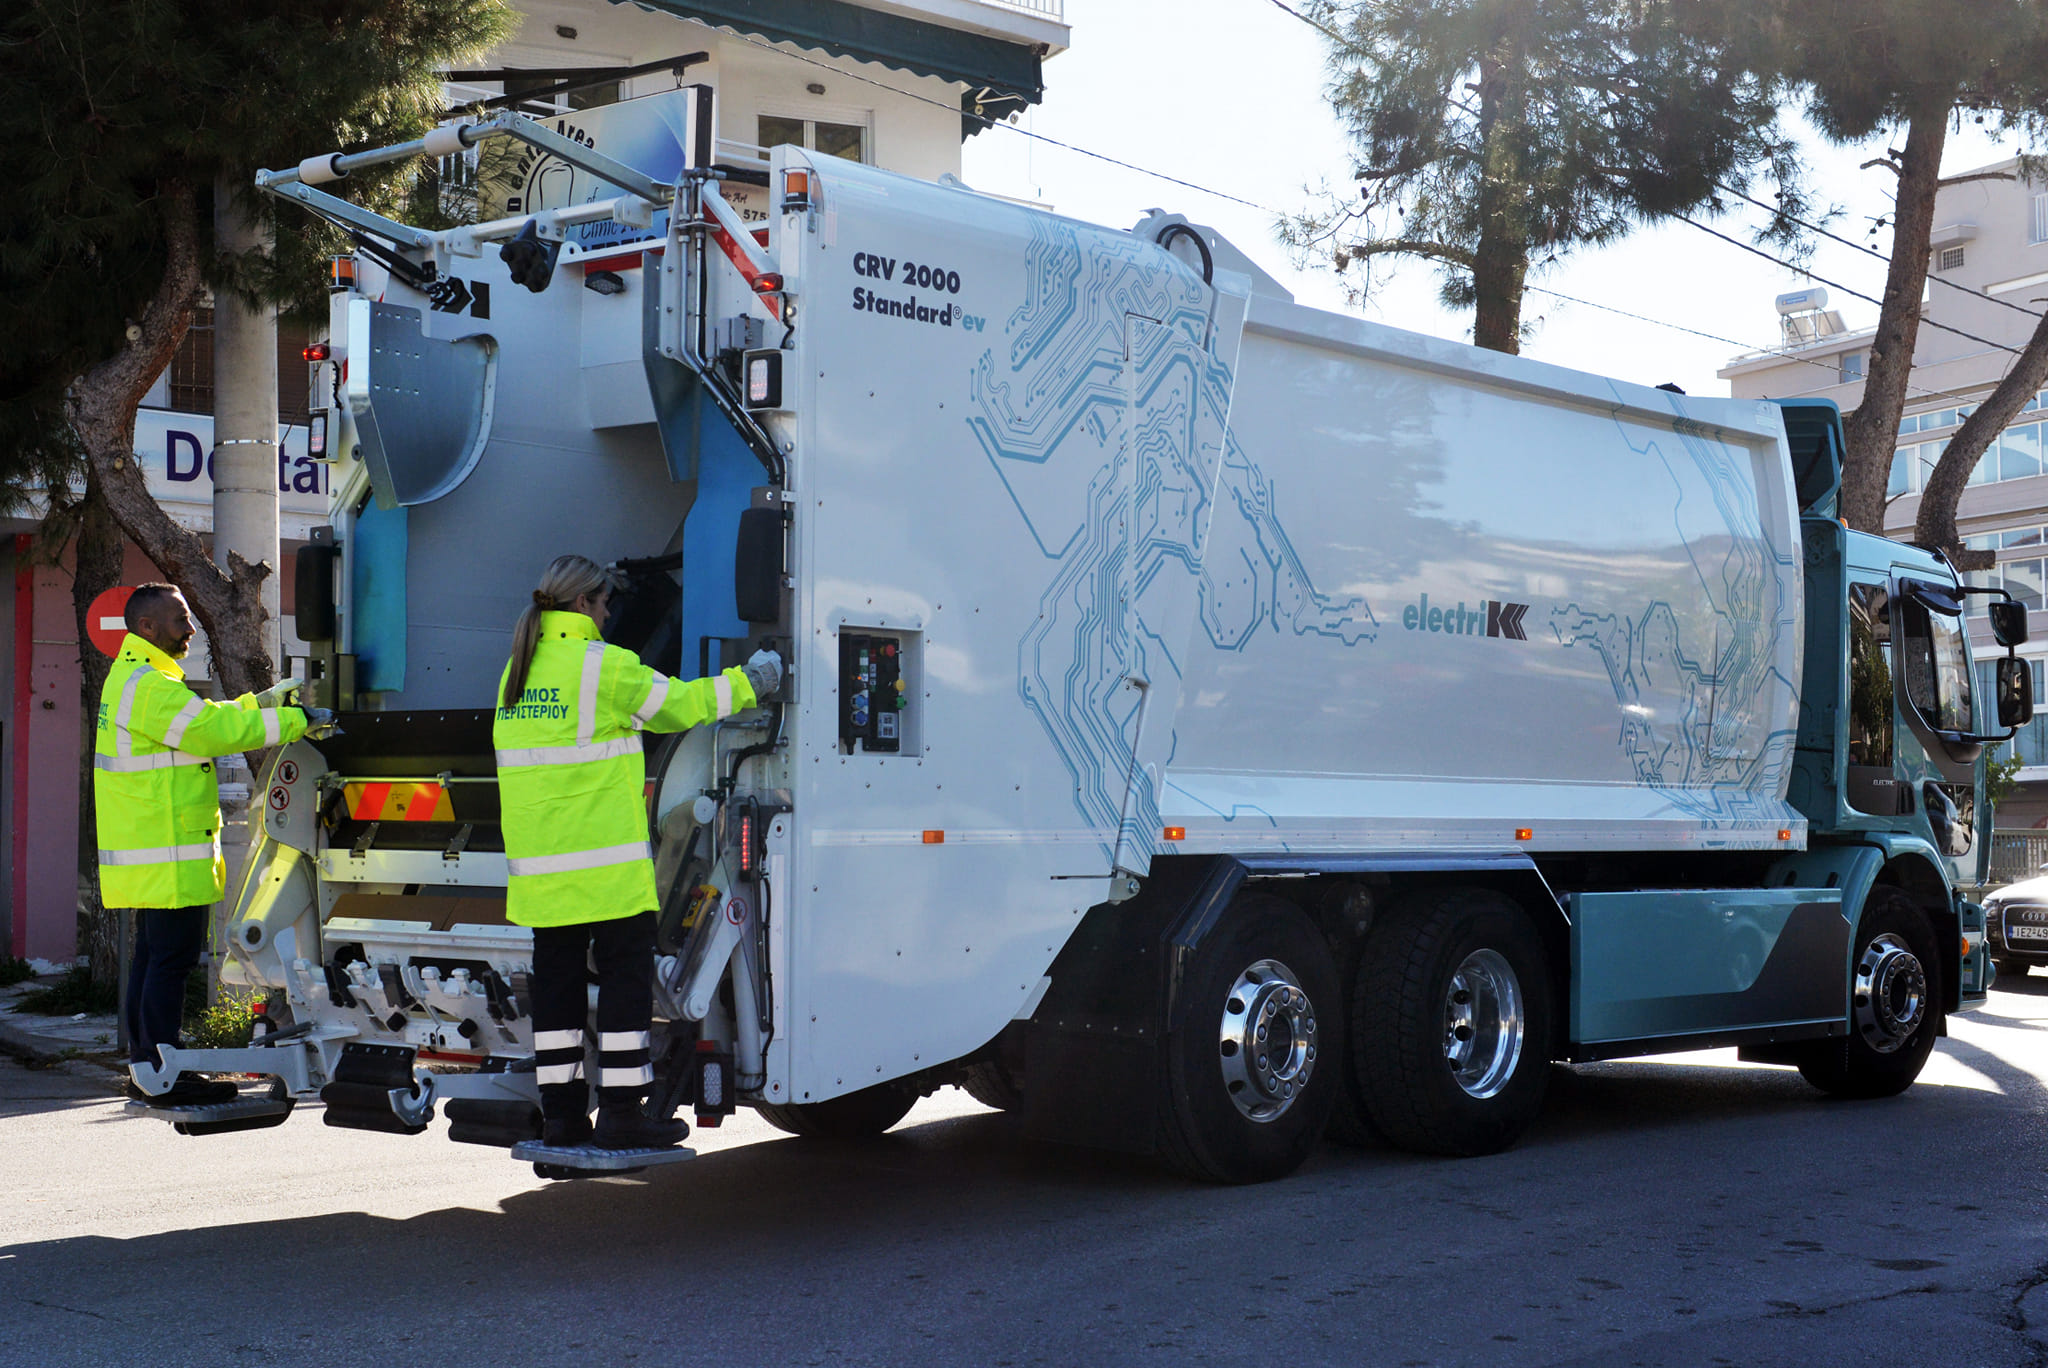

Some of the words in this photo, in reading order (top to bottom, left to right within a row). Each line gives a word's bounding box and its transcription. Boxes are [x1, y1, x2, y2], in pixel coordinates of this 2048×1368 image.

[743, 209, 769, 221] 575
[853, 252, 896, 281] CRV
[902, 262, 960, 294] 2000
[497, 705, 569, 720] ΠΕΡΙΣΤΕΡΙΟΥ
